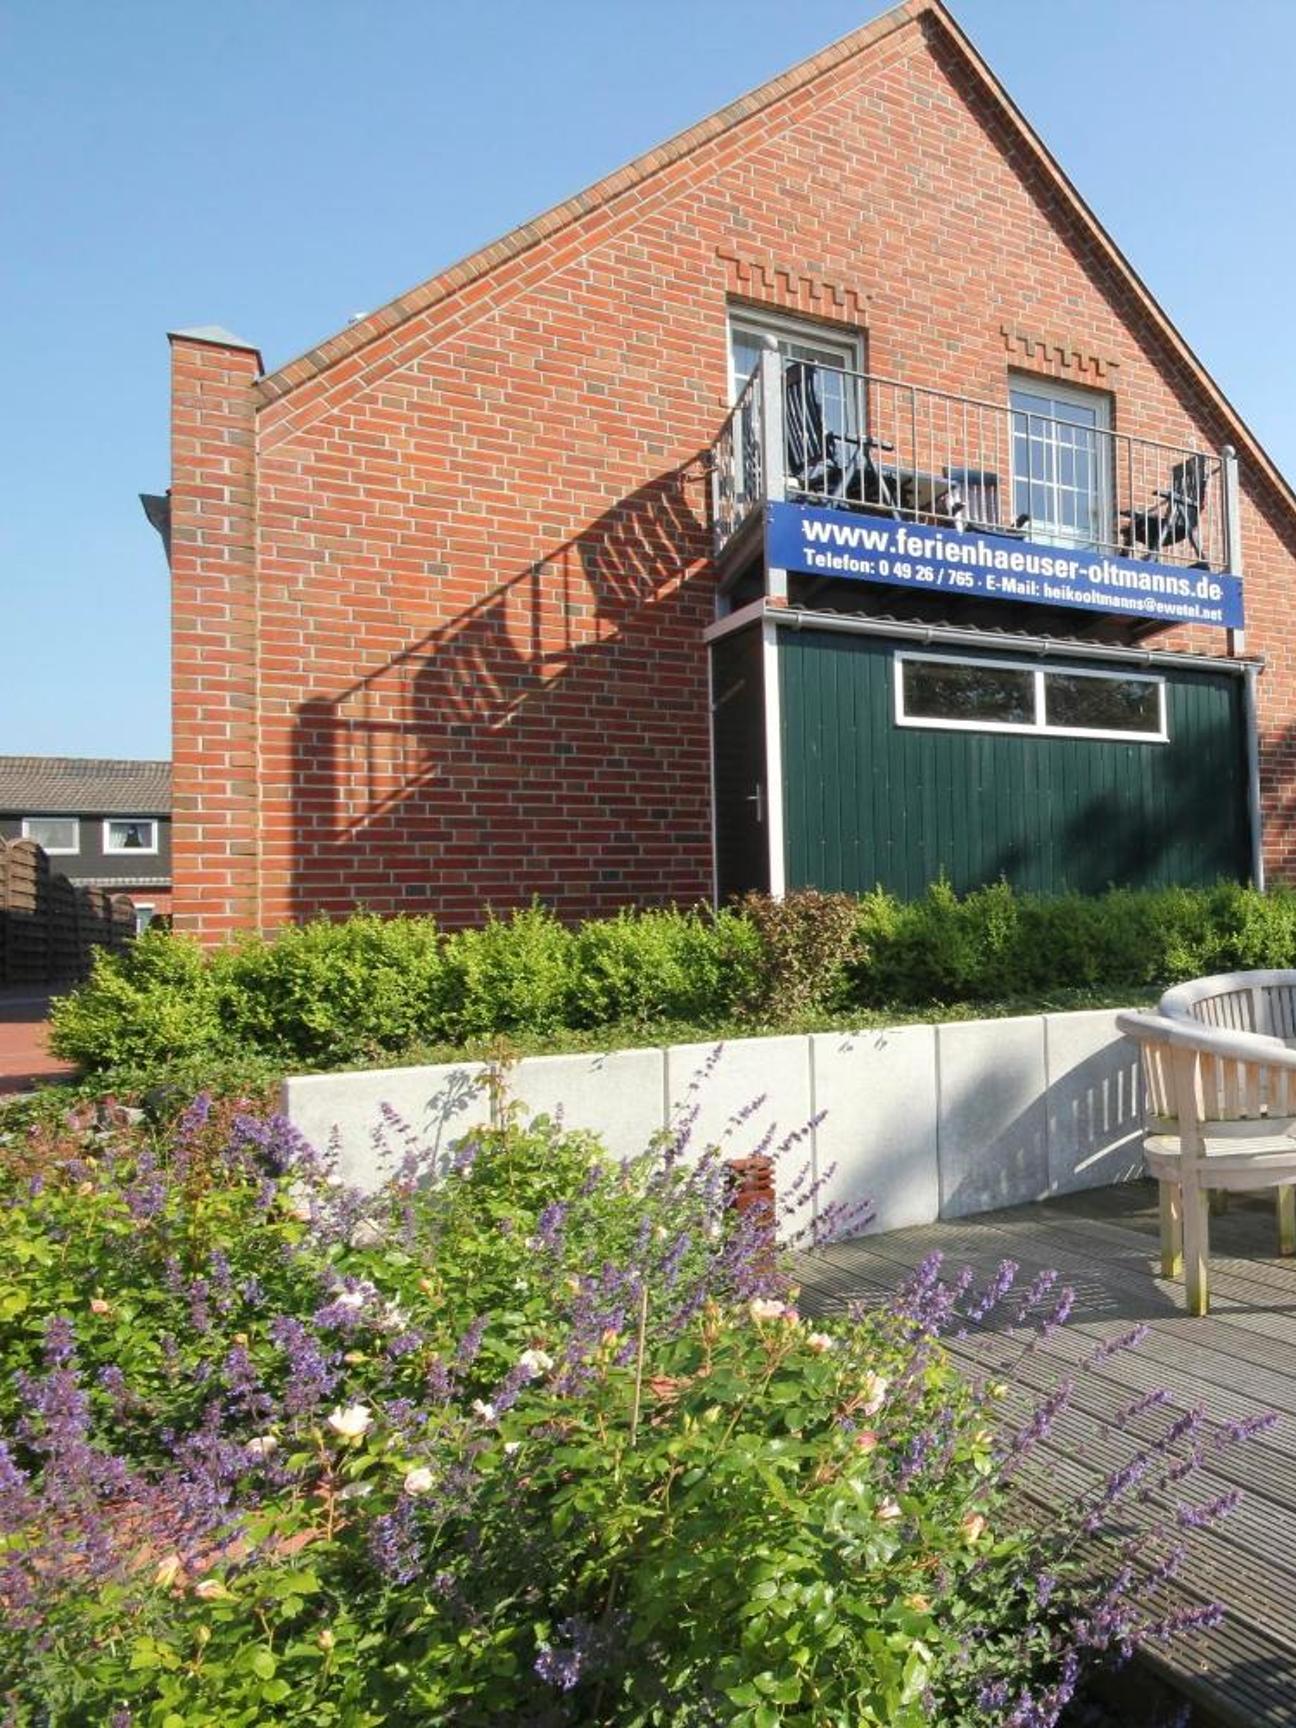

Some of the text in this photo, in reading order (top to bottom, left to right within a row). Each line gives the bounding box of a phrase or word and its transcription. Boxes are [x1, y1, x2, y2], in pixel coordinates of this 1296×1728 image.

[802, 520, 1223, 600] www.ferienhaeuser-oltmanns.de
[804, 548, 875, 575] Telefon:
[879, 561, 889, 576] 0
[893, 563, 912, 580] 49
[916, 566, 934, 582] 26
[937, 568, 945, 585] /
[948, 570, 974, 588] 765
[986, 575, 1040, 597] E-Mail:
[1043, 582, 1223, 621] heikooltmanns@ewetel.net
